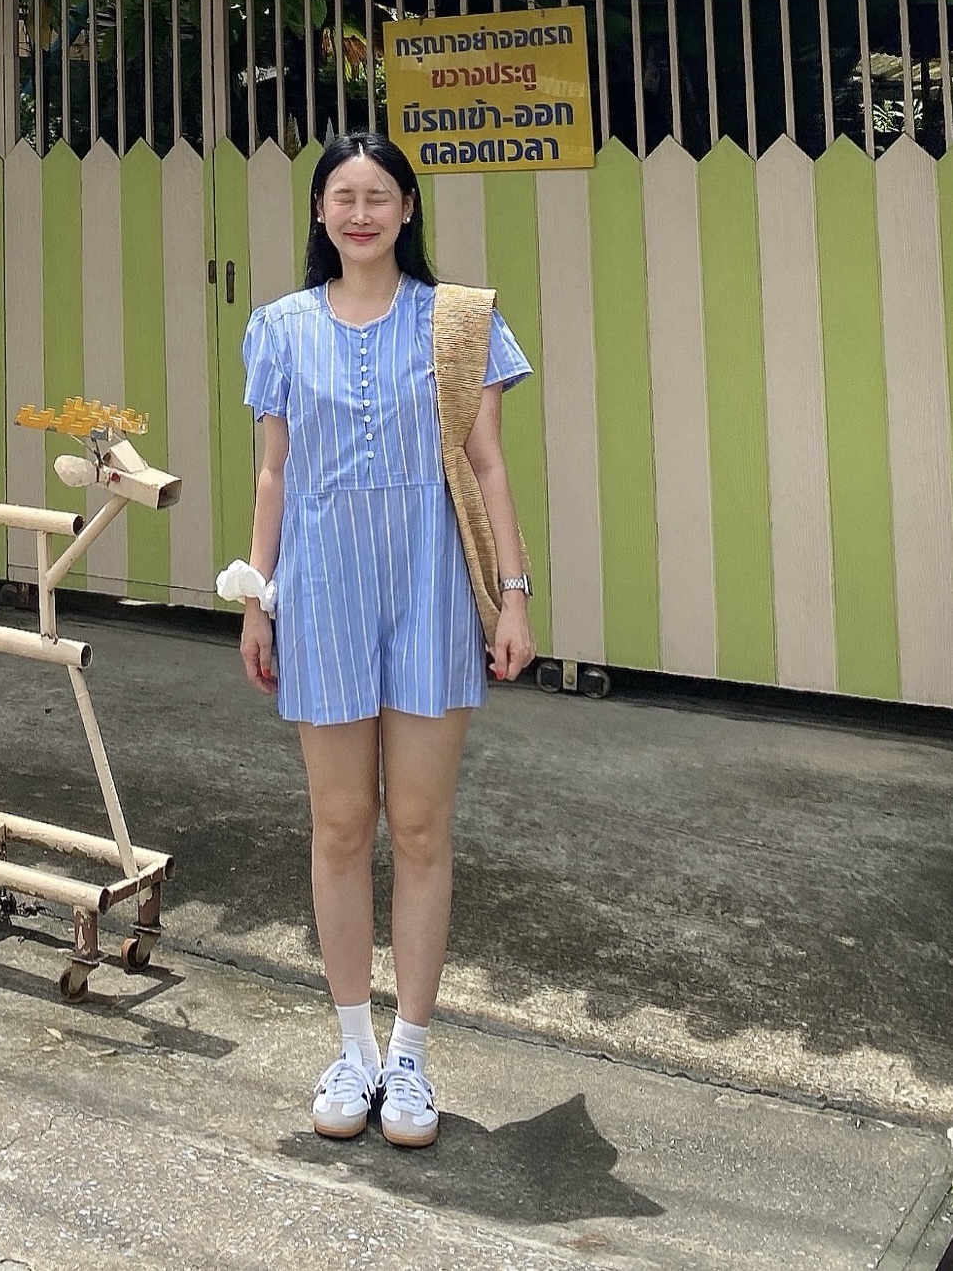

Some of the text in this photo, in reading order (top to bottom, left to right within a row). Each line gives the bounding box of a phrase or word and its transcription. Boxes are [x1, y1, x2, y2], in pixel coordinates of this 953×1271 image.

[396, 26, 572, 62] กรุณาอย่าจอดรถ
[432, 62, 536, 91] ขวางประตู
[403, 99, 573, 133] มีรถเข้า-ออก
[420, 137, 559, 164] ตลอดเวลา
